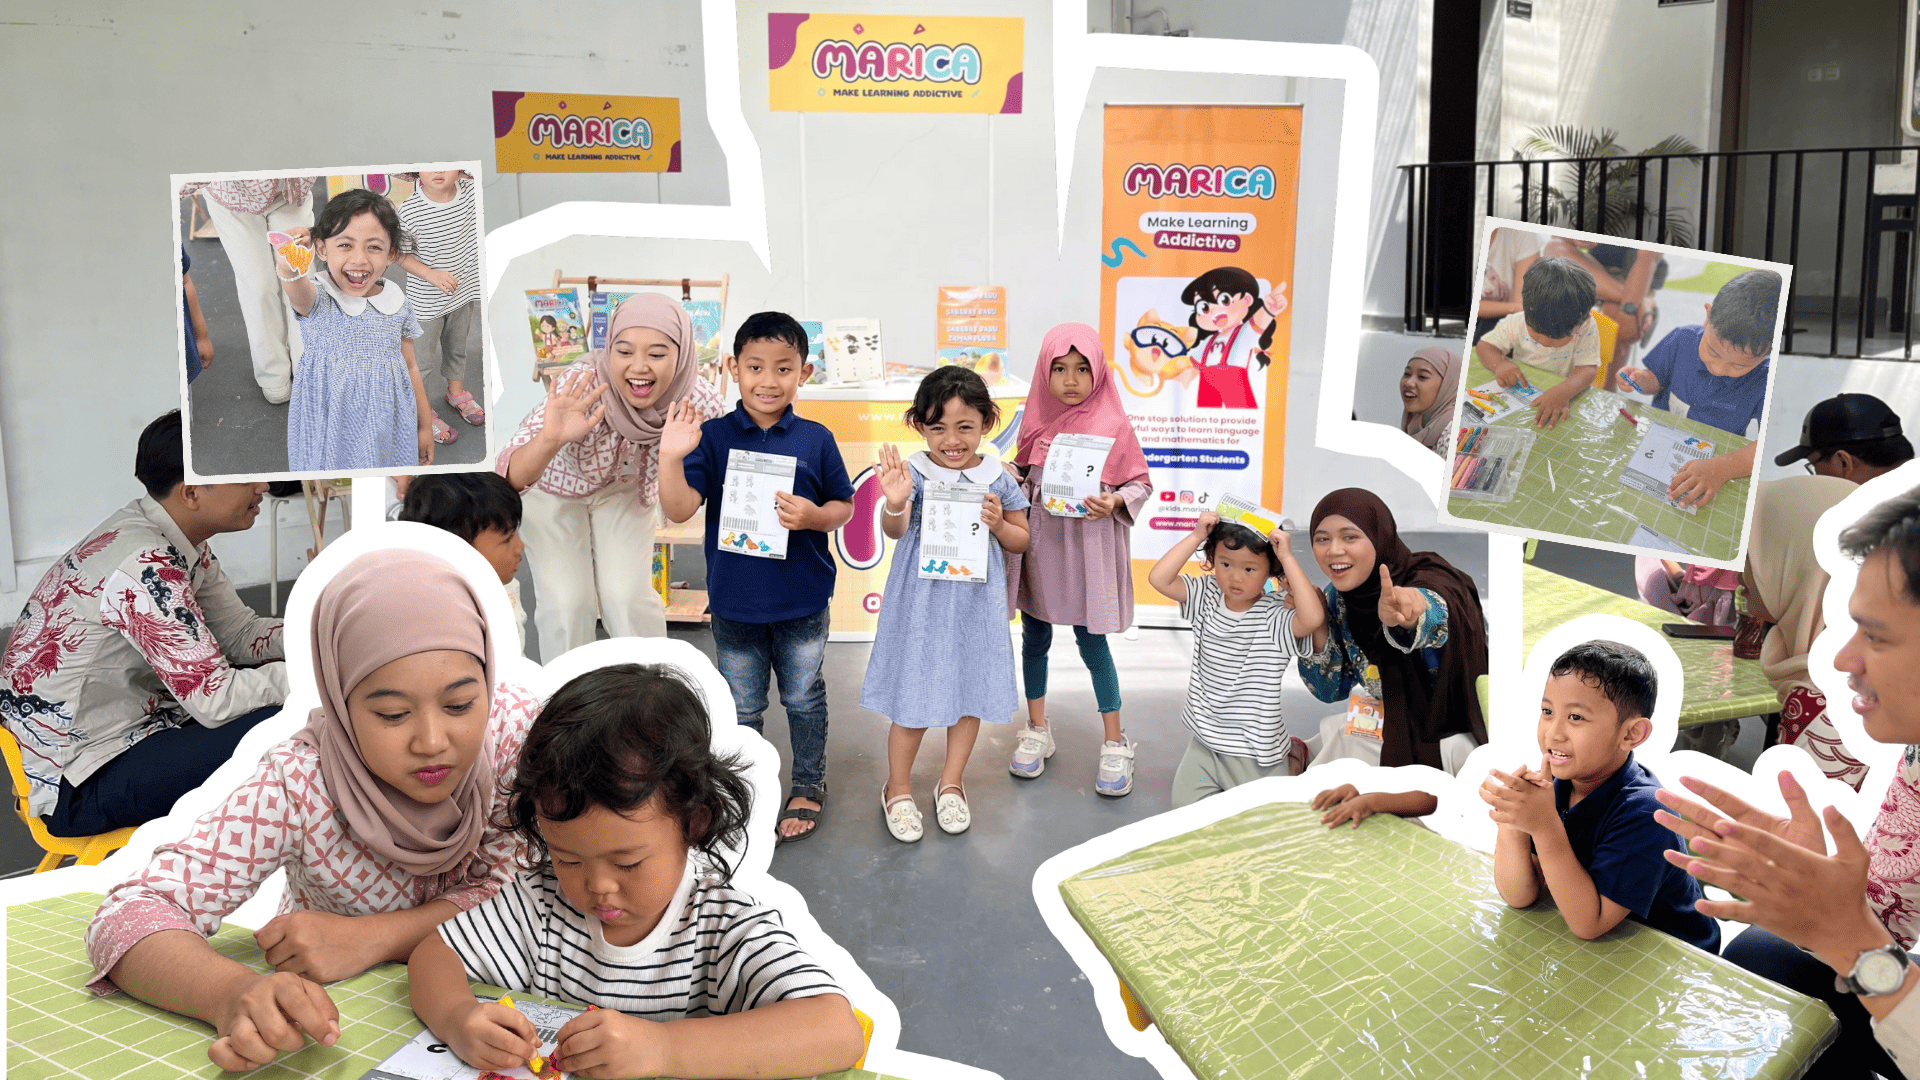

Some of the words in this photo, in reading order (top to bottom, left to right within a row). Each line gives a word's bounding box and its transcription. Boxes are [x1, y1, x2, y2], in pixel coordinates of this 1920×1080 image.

[812, 39, 982, 85] MARICA
[833, 89, 859, 97] MAKE
[862, 89, 910, 97] LEARNING
[912, 90, 963, 98] ADDICTIVE
[528, 113, 653, 150] MARICA
[1123, 162, 1277, 200] MARICA
[1147, 217, 1185, 229] Make
[1188, 217, 1249, 232] Learning
[1158, 233, 1236, 250] Addictive
[1127, 414, 1145, 422] One
[1147, 415, 1168, 424] stop
[1170, 415, 1207, 423] solution
[1209, 416, 1219, 424] to
[1220, 416, 1257, 426] provide
[1151, 426, 1175, 435] ways
[1177, 425, 1186, 433] to
[1188, 425, 1212, 433] learn
[1214, 426, 1260, 437] language
[1141, 435, 1160, 443] and
[1162, 436, 1225, 445] mathematics
[1227, 437, 1240, 445] for
[1199, 454, 1246, 464] Students
